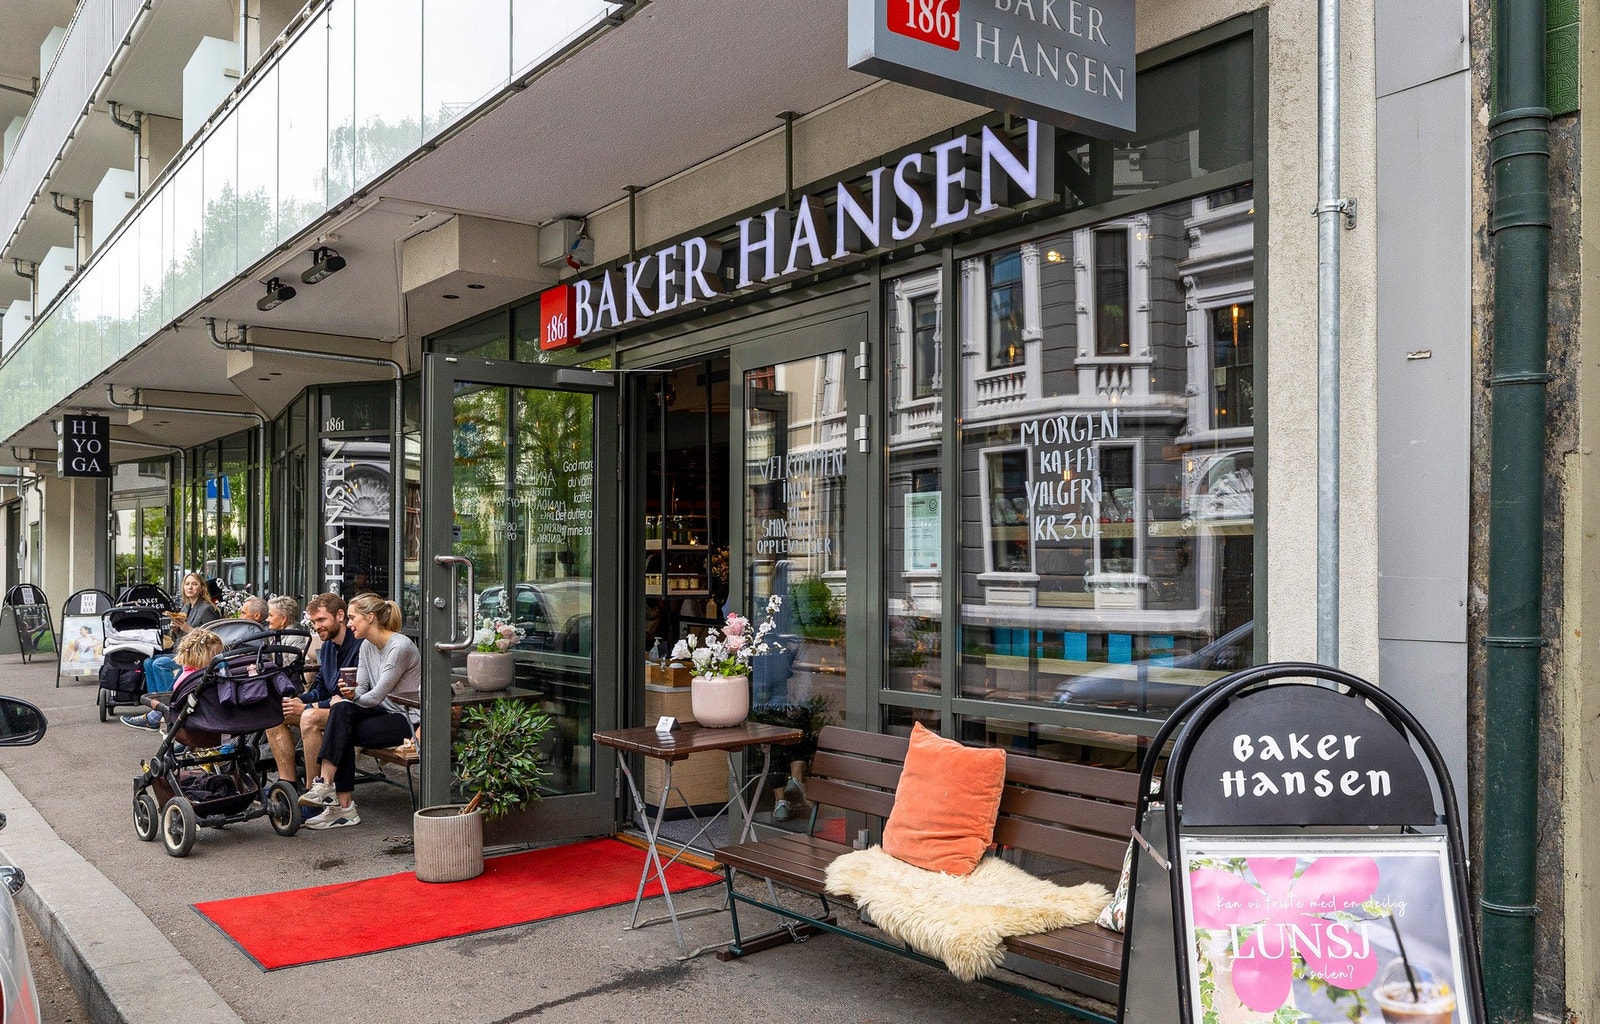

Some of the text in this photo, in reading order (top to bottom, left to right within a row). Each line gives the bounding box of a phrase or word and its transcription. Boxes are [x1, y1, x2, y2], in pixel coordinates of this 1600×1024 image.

[905, 0, 960, 41] 1861
[974, 20, 1126, 100] HANSEN
[546, 120, 1037, 343] 1861 BAKER HANSEN
[72, 420, 98, 435] HI
[325, 417, 345, 432] 1861
[1020, 408, 1118, 447] MORGEN
[72, 438, 102, 454] YO
[1040, 447, 1097, 474] KAFFE
[72, 457, 102, 472] GA
[563, 460, 577, 472] God
[758, 446, 843, 481] VELKOMMEN
[1025, 475, 1103, 507] VALGFRI
[325, 440, 345, 583] HANSEN
[1035, 515, 1060, 541] KR
[1232, 732, 1362, 763] Baker
[1219, 768, 1393, 798] Hansen
[1216, 894, 1408, 917] Kan vi friste med en deilig
[1226, 923, 1372, 960] LUNSJ
[1310, 964, 1355, 982] solen?
